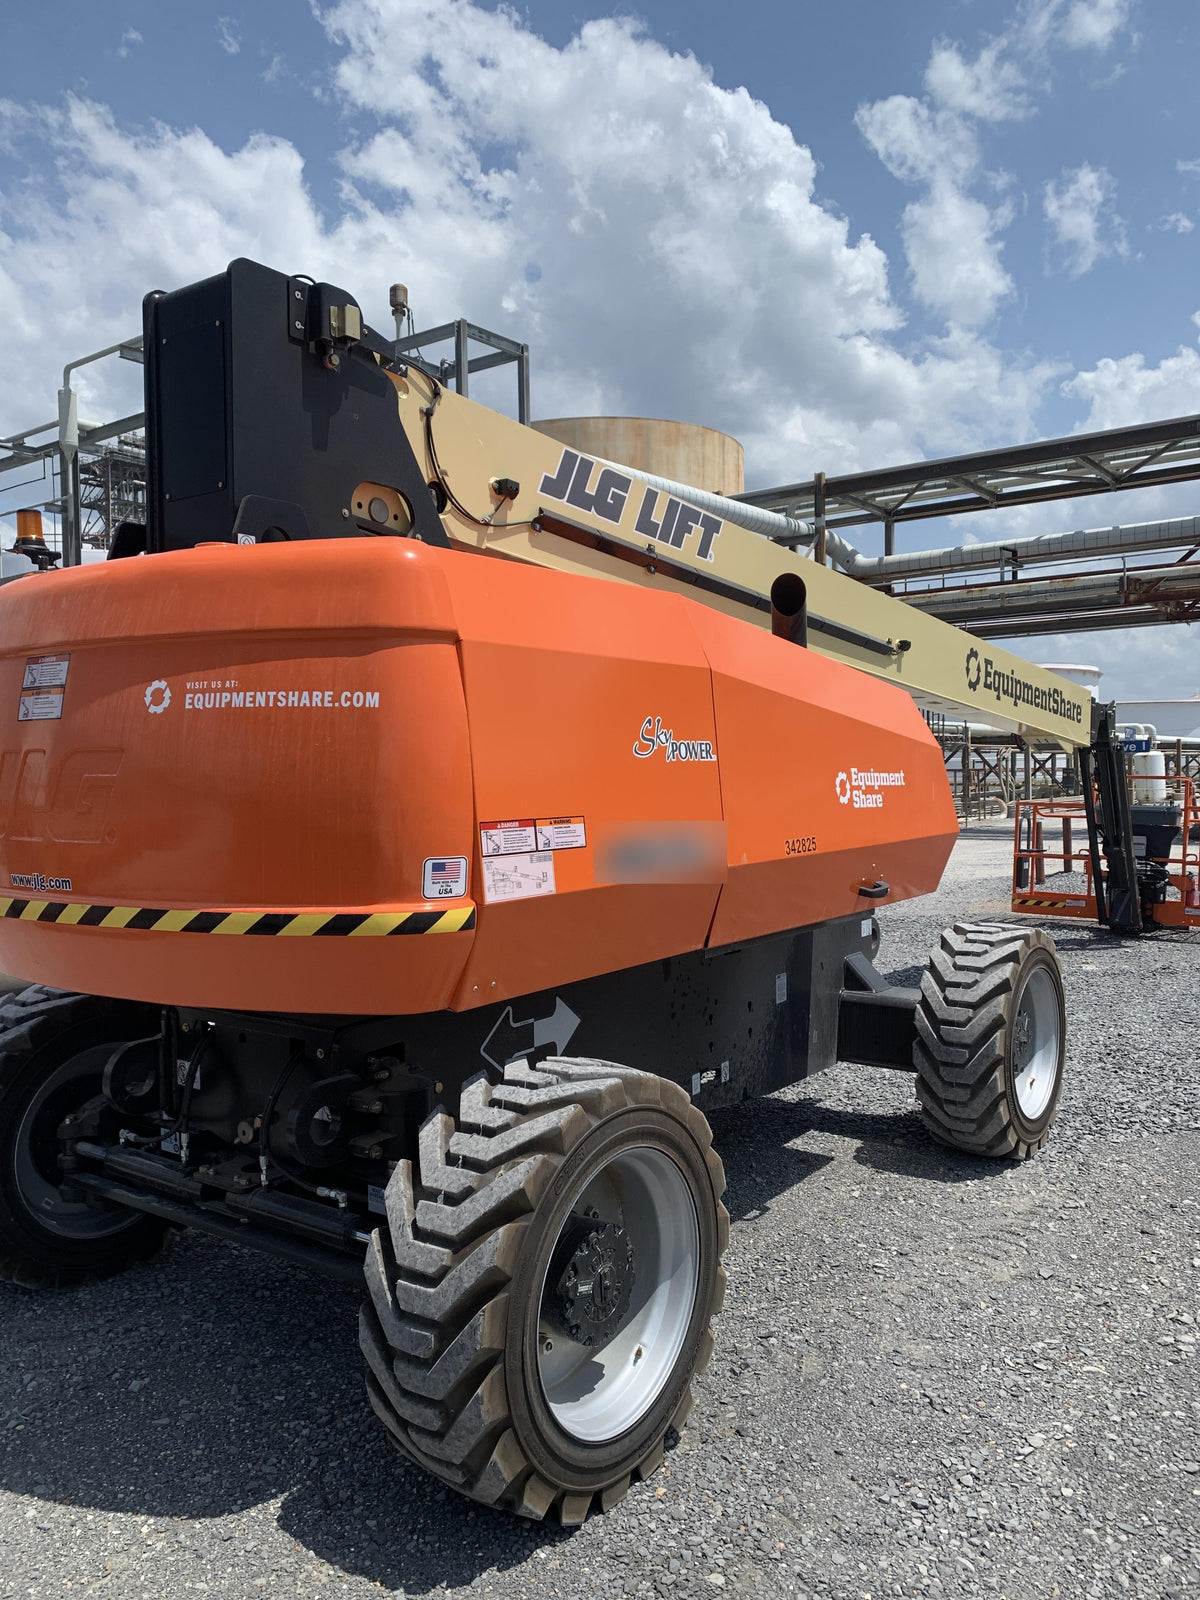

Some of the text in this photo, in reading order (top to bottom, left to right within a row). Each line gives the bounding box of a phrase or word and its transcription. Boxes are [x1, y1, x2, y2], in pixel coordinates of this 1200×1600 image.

[537, 448, 724, 561] JLG LIFT
[186, 680, 239, 690] VISIT US AT:
[983, 658, 1082, 724] EquipmentShare
[184, 690, 380, 709] EQUIPMENTSHARE.COM
[633, 716, 713, 763] Sky POWER
[850, 767, 906, 790] Equipment
[852, 790, 884, 808] Share
[784, 836, 817, 856] 342825
[11, 873, 72, 891] www.jlg.com
